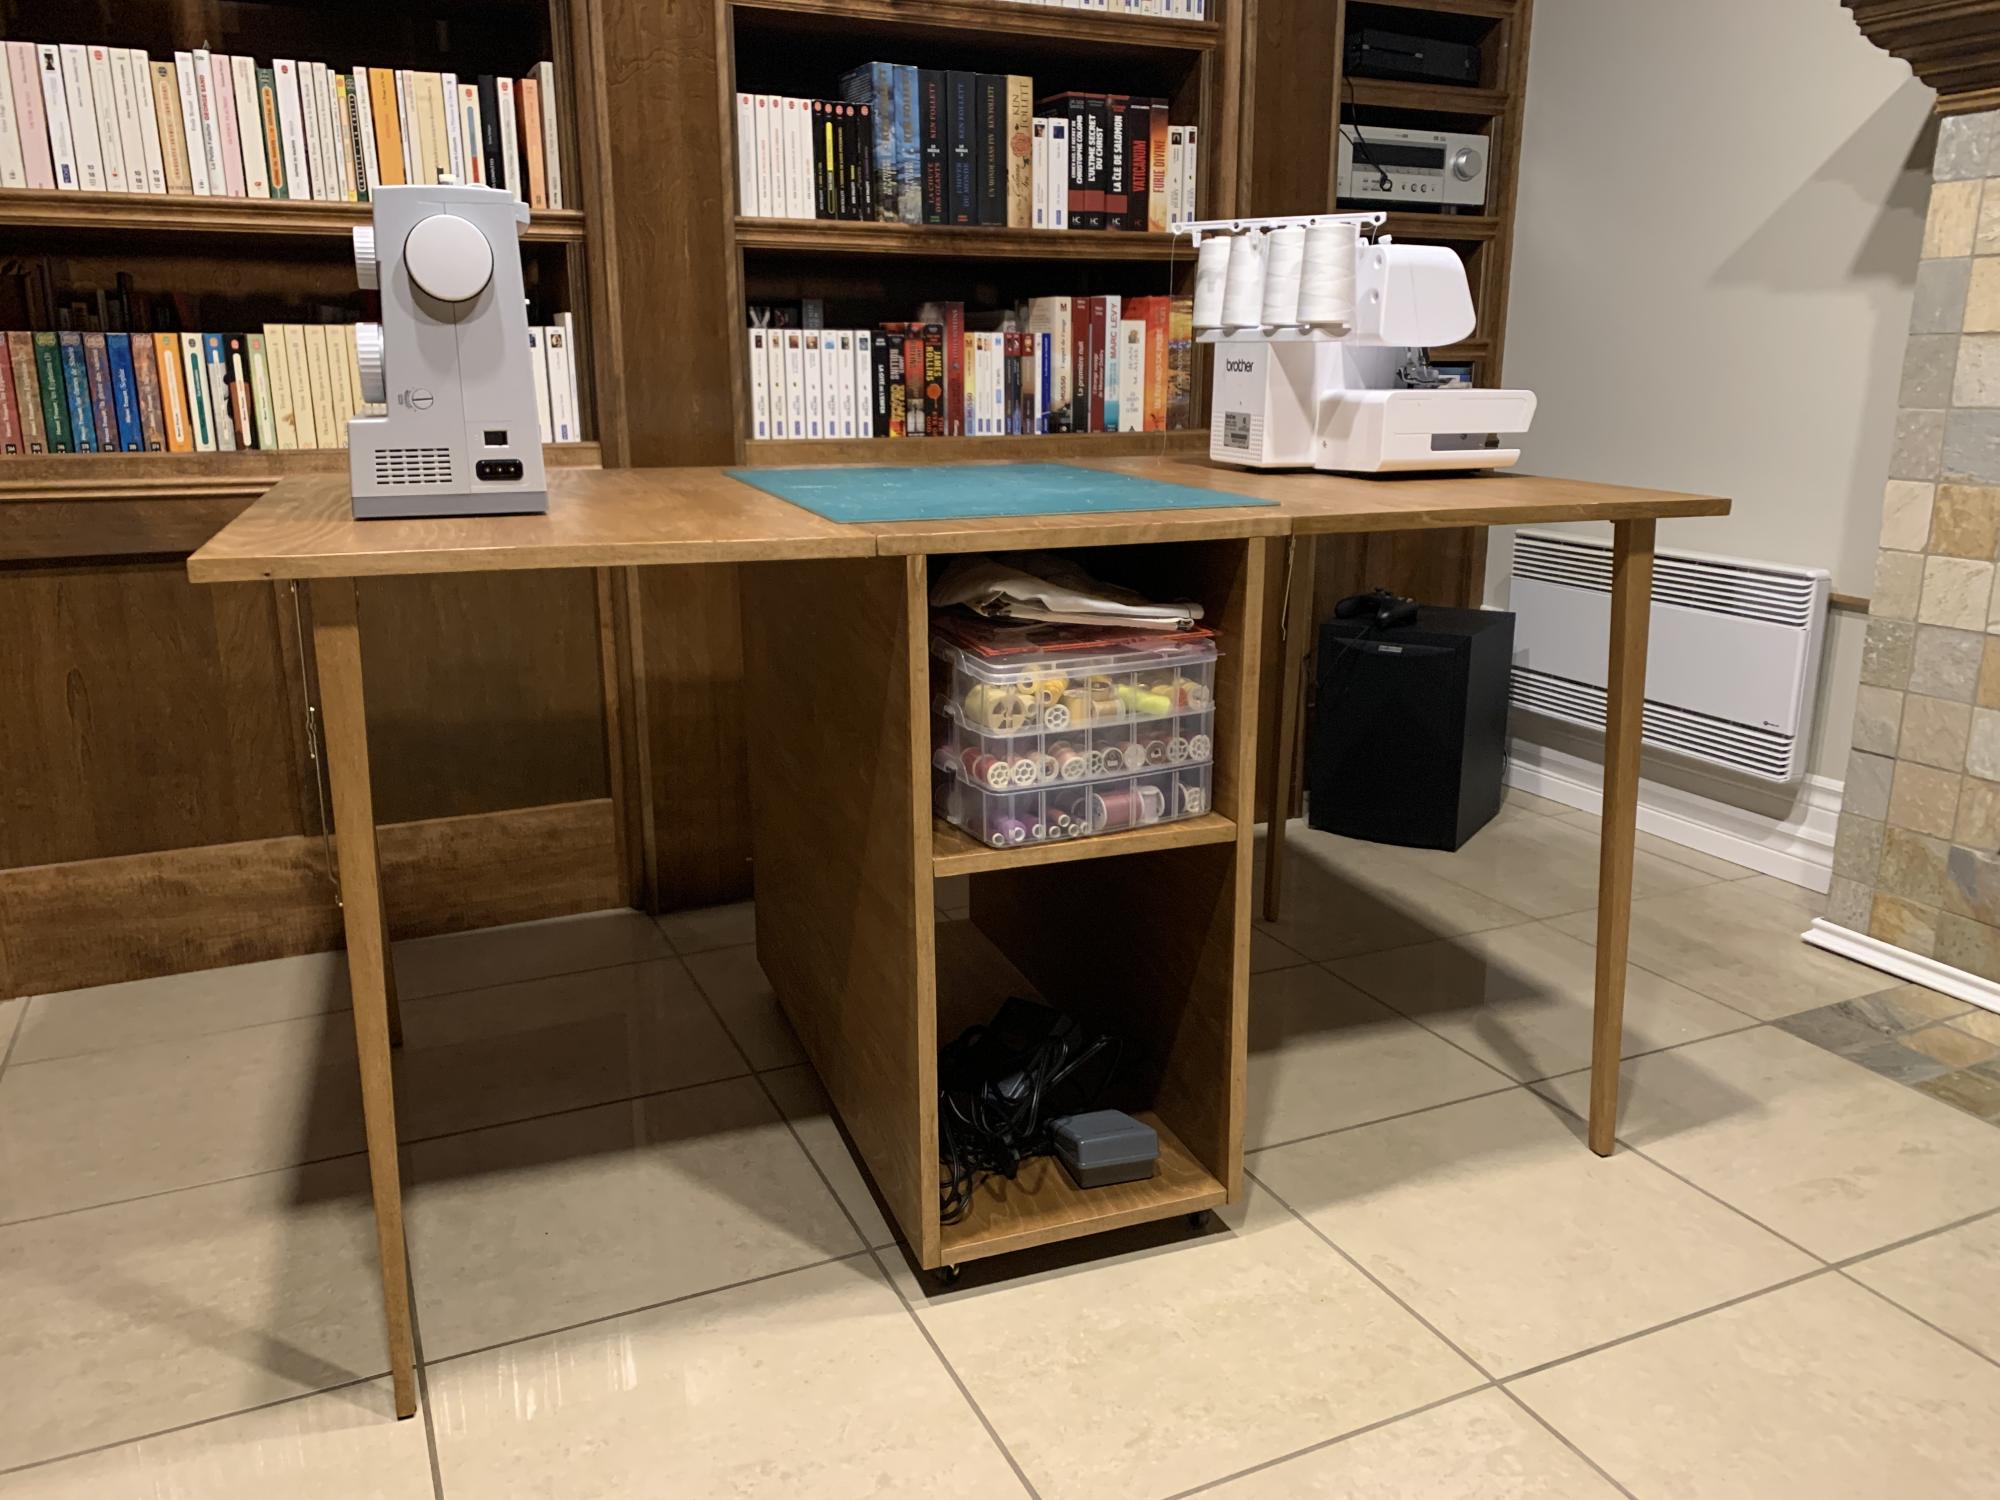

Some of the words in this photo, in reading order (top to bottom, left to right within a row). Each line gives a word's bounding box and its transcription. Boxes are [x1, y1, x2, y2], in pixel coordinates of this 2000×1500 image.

[1020, 83, 1029, 128] FOLLETT
[1088, 114, 1096, 145] SECRET
[1114, 115, 1122, 153] SALOMON
[1096, 158, 1103, 170] DU
[1114, 155, 1121, 165] DE
[1132, 139, 1146, 192] VATICANUM
[1153, 140, 1165, 167] DIVINE
[1113, 182, 1122, 192] LA
[1153, 170, 1165, 193] FURIE
[890, 349, 899, 380] ROLLINS
[926, 347, 934, 381] ROLLINS
[934, 351, 942, 377] JAMES
[1226, 359, 1254, 372] brother
[1078, 388, 1084, 396] La
